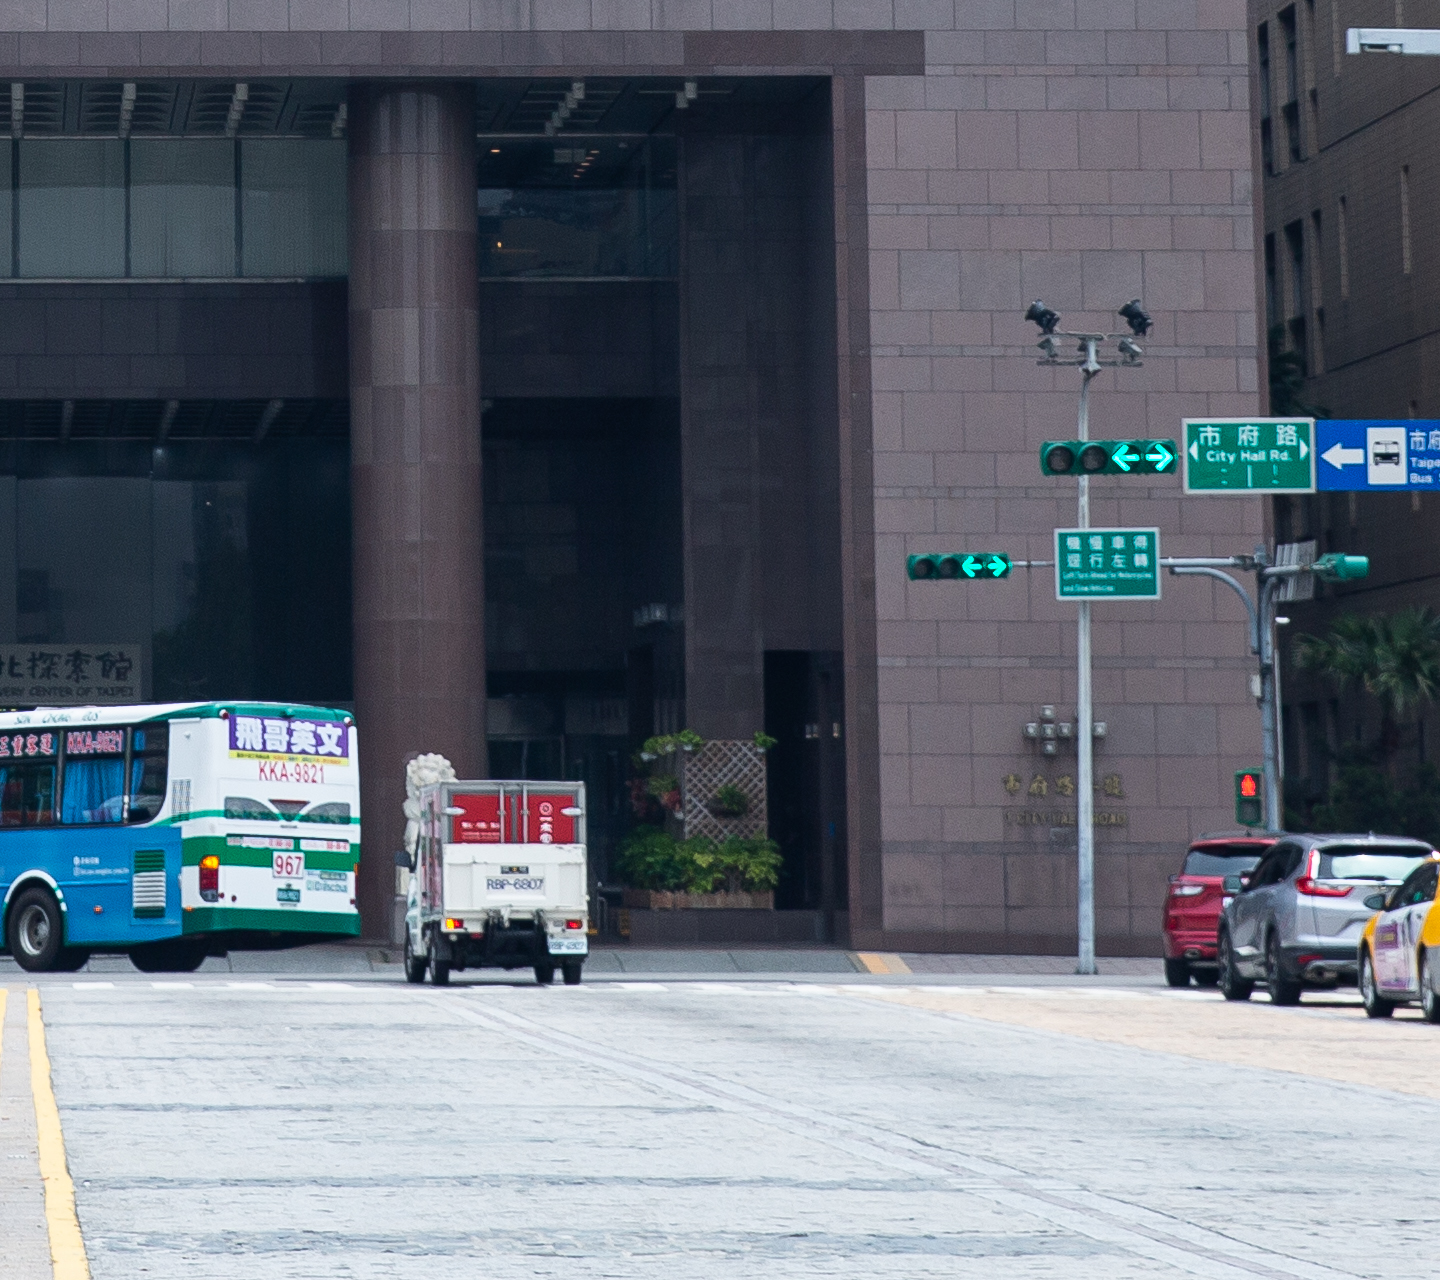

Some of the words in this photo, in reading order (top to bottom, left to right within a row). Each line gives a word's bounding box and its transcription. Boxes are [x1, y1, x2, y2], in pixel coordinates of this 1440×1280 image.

[1198, 425, 1298, 447] 市府路
[1206, 450, 1237, 464] City
[1240, 449, 1267, 462] Hall
[1269, 449, 1293, 462] Rd.
[1410, 472, 1433, 484] Bus
[235, 716, 343, 756] 飛哥英文
[258, 760, 325, 784] KKA-9821
[275, 855, 303, 876] 967
